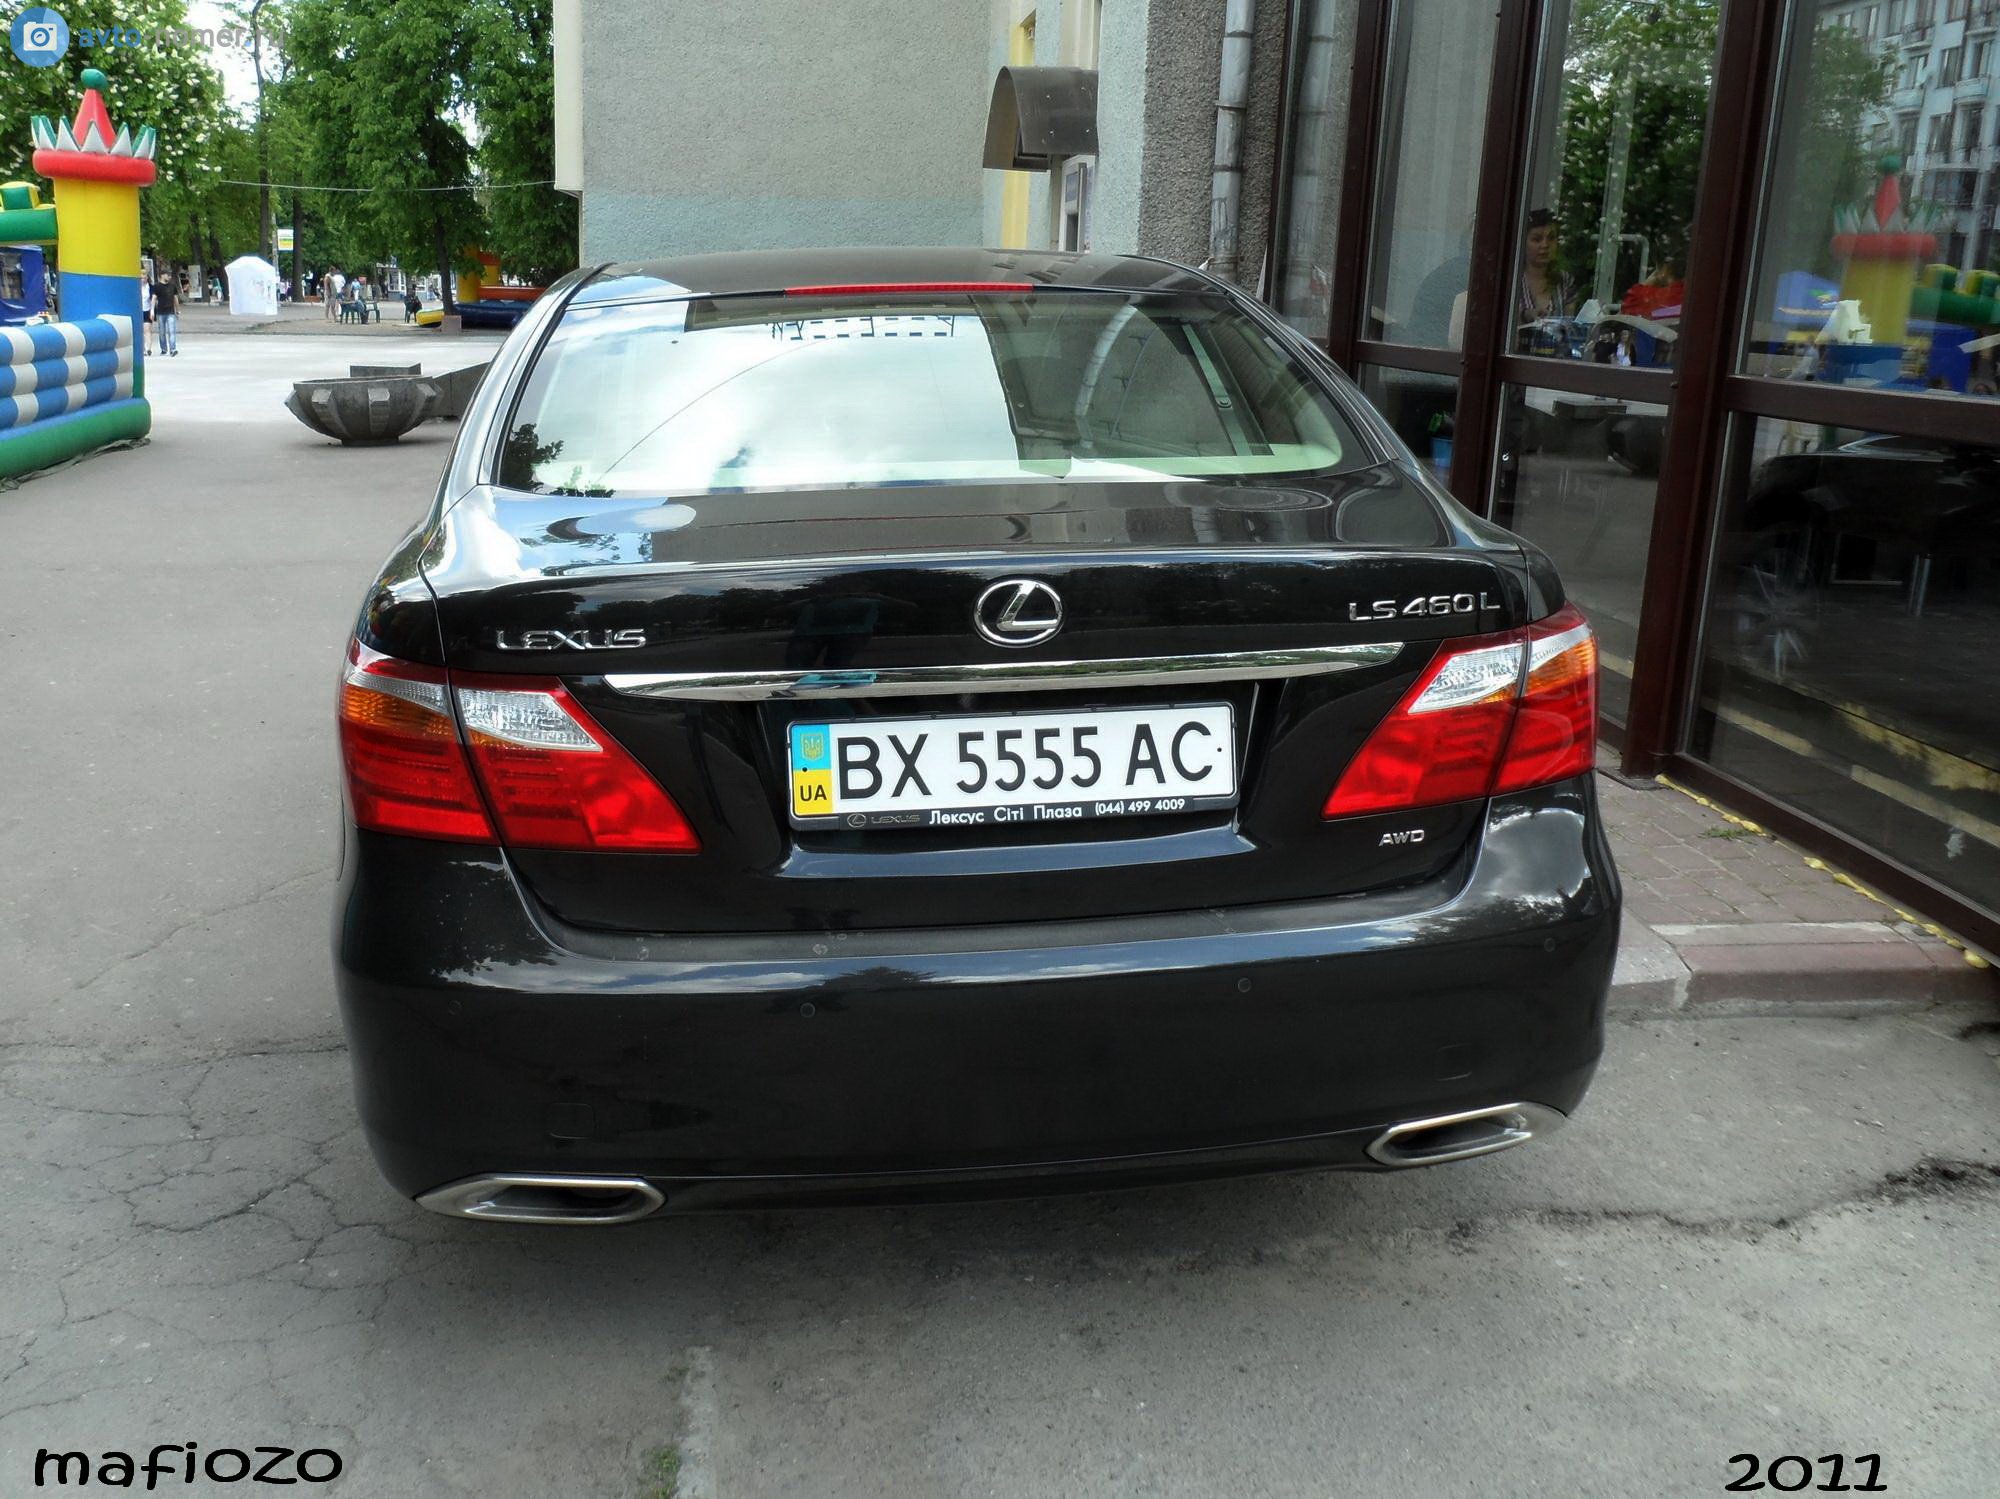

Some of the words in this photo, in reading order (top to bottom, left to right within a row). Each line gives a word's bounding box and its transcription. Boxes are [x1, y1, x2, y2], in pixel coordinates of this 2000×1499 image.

[496, 628, 647, 650] LEXUS
[800, 785, 828, 802] UA
[837, 733, 932, 800] BX
[955, 726, 1102, 794] 5555
[1124, 720, 1214, 786] AC
[871, 814, 921, 825] LEXUS
[928, 810, 985, 825] Лексус
[1033, 805, 1083, 820] Плаза
[1094, 801, 1125, 817] (044)
[1128, 800, 1151, 813] 499
[1154, 798, 1186, 811] 4009
[1378, 829, 1425, 846] AWD
